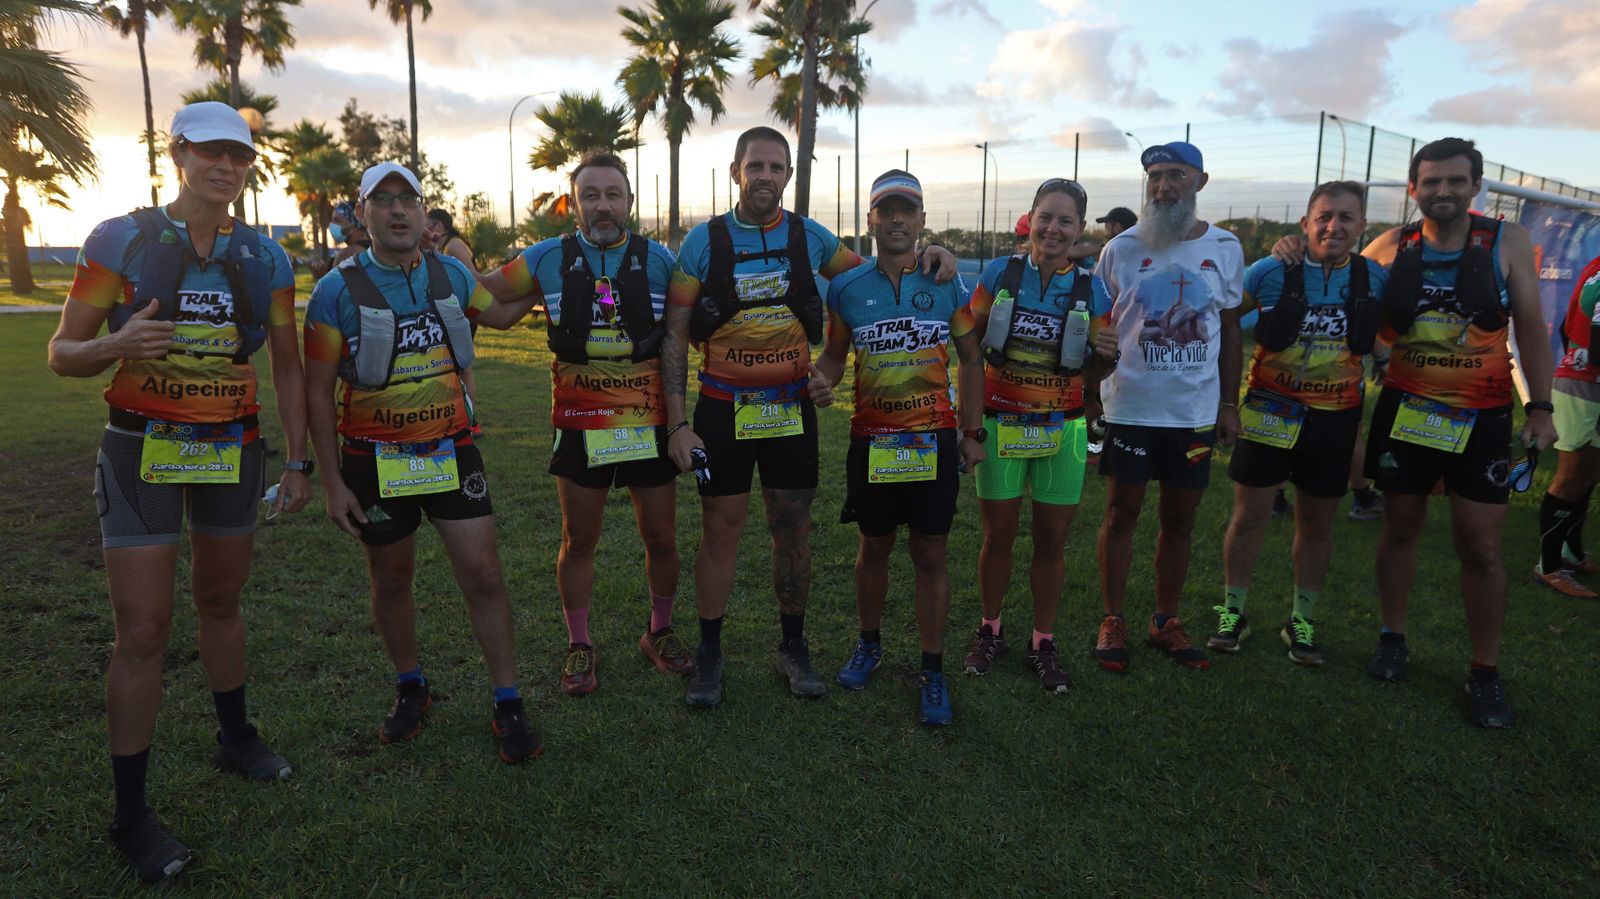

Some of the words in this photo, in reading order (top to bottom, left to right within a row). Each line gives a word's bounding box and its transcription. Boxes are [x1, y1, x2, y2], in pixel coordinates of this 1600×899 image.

[742, 276, 779, 294] TRAIL
[876, 320, 914, 338] TRAIL
[1013, 325, 1039, 337] EAM
[1299, 321, 1329, 333] EAM
[171, 336, 209, 346] abarras
[868, 337, 905, 353] TEAM
[907, 326, 940, 351] 3x4
[725, 347, 800, 367] Algeciras
[1142, 341, 1168, 362] Vive
[1170, 341, 1182, 362] la
[1186, 341, 1208, 362] vida
[878, 360, 907, 369] Gabarras
[908, 359, 914, 367] &
[1402, 350, 1482, 368] Algeciras
[574, 374, 650, 391] Algeciras
[1000, 370, 1070, 388] Algeciras
[140, 376, 247, 400] Algeciras
[372, 403, 456, 428] Algeciras
[598, 408, 615, 416] Rojo
[761, 405, 778, 417] 214
[1263, 414, 1280, 426] 193
[1426, 414, 1443, 428] 98
[614, 427, 628, 440] 58
[1023, 427, 1039, 438] 170
[179, 443, 209, 456] 262
[896, 449, 910, 461] 50
[409, 458, 426, 471] 83
